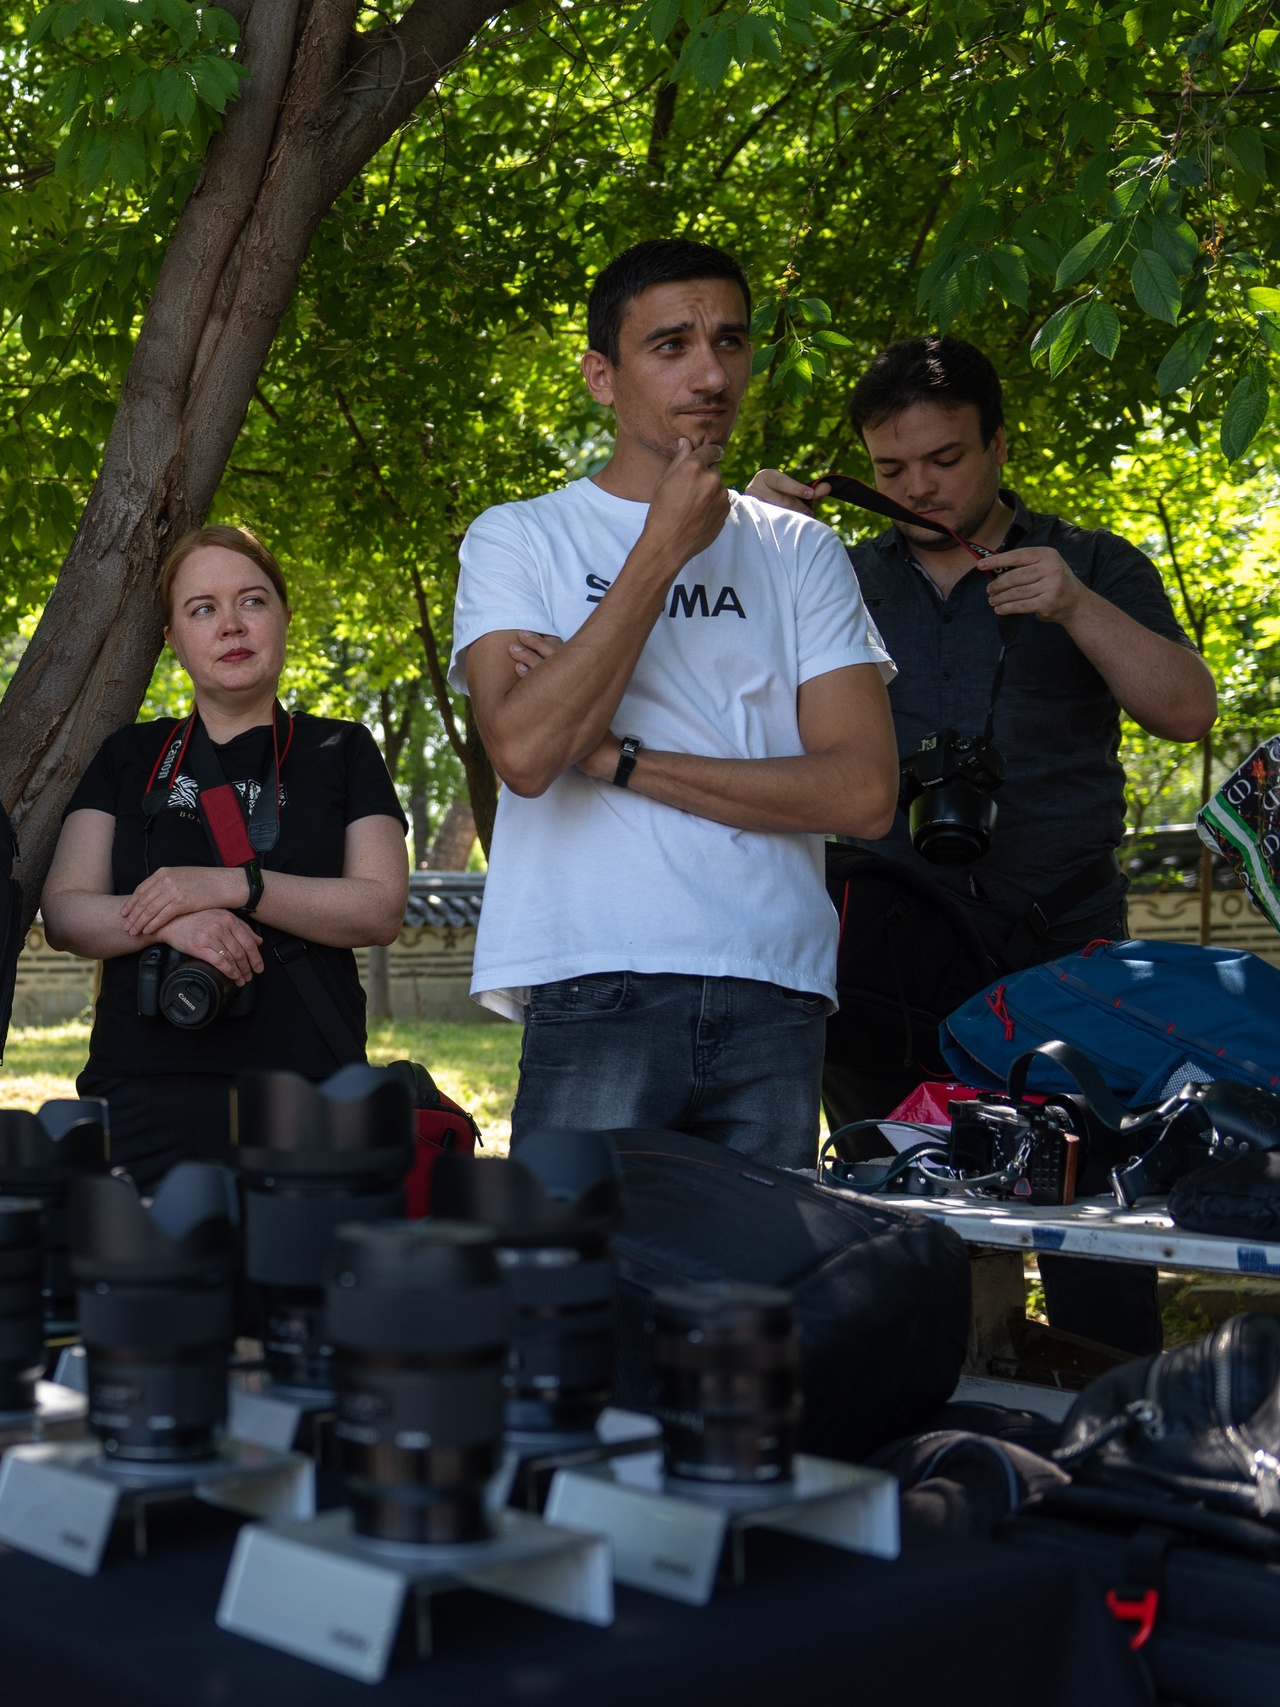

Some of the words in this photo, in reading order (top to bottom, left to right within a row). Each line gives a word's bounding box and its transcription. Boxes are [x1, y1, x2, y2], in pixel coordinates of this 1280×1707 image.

[586, 573, 748, 620] SMA
[157, 739, 183, 781] Canon
[921, 776, 944, 788] Canon
[177, 991, 197, 1012] Canon
